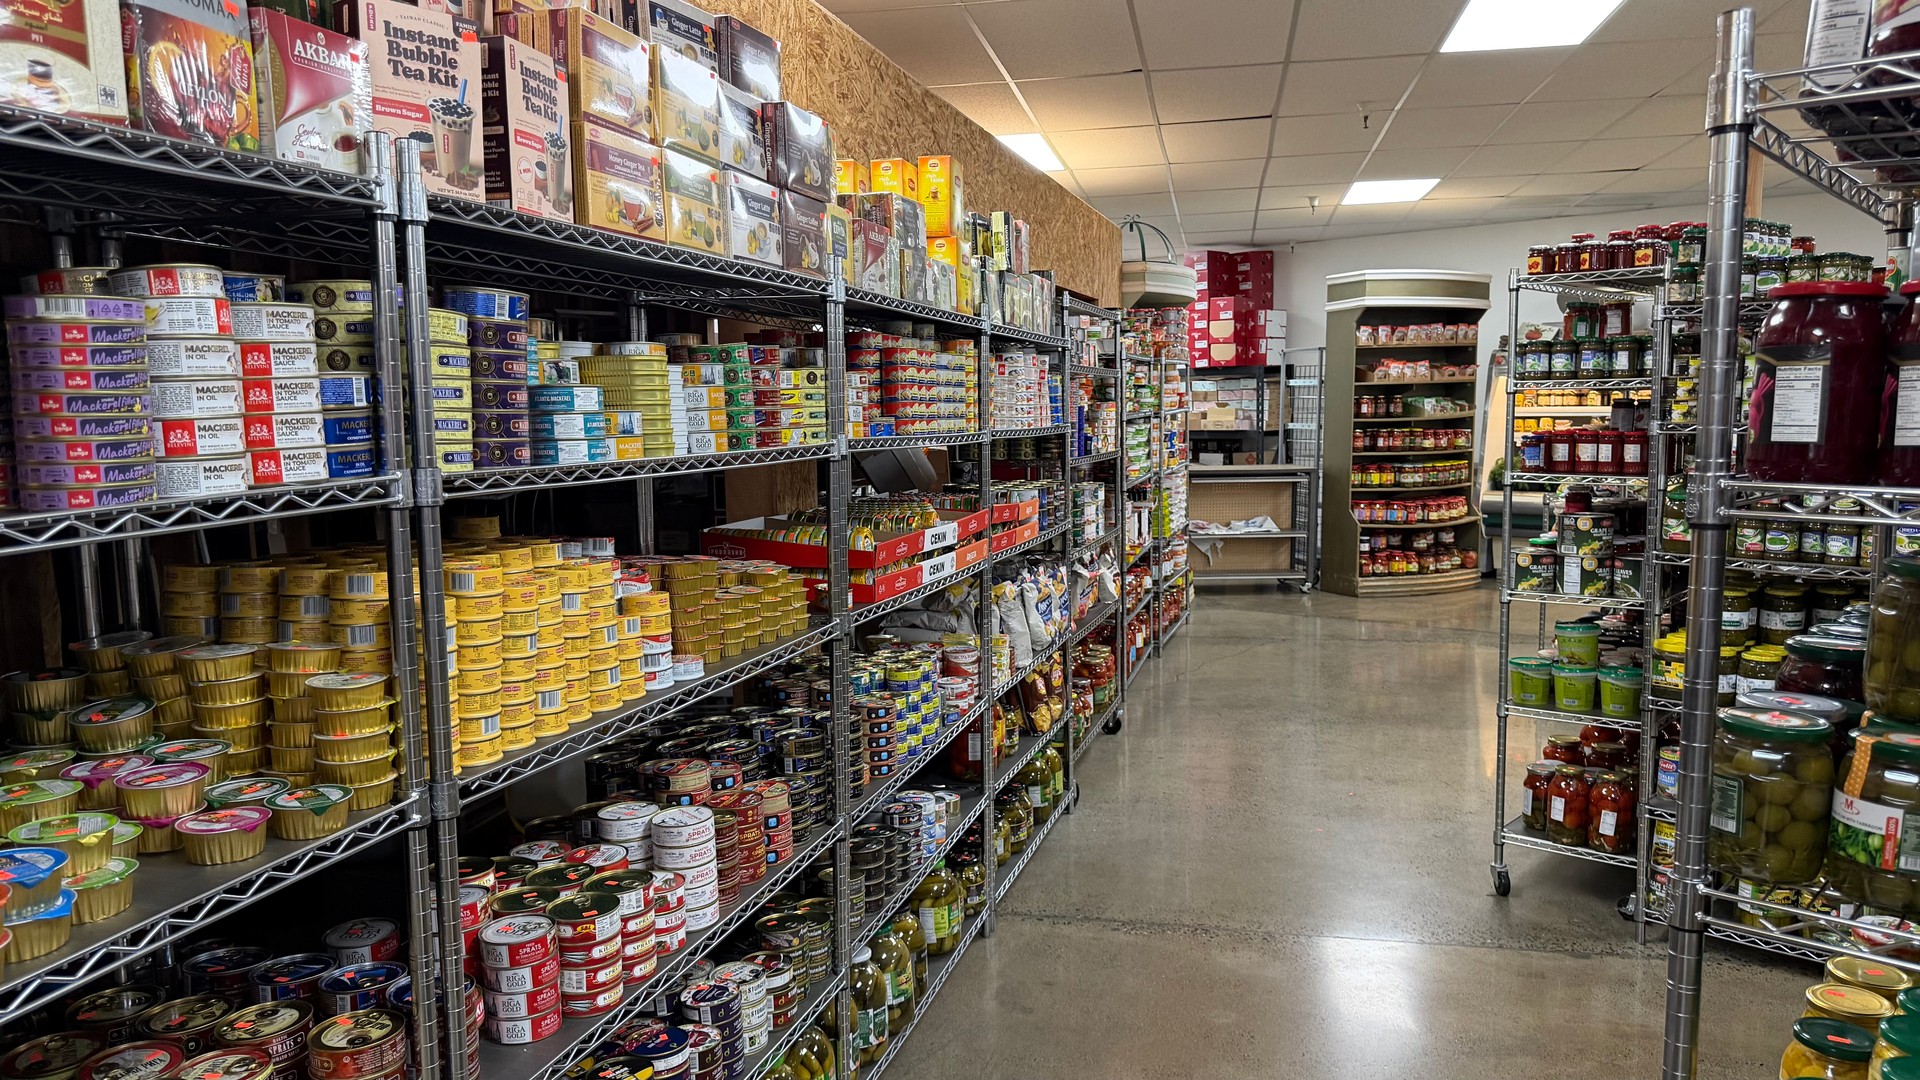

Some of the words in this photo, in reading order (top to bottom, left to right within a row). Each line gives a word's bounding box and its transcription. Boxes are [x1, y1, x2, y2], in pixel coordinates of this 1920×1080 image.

[400, 15, 421, 23] TAIWAN
[455, 21, 477, 32] FAMILY
[671, 17, 688, 32] Ginger
[688, 23, 702, 36] Latte
[383, 19, 460, 53] Instant
[386, 39, 459, 71] Bubble
[387, 58, 426, 82] Tea
[428, 66, 459, 89] Kit
[519, 60, 558, 91] Instant
[178, 80, 228, 106] CEYLON
[521, 78, 558, 107] Bubble
[375, 104, 401, 116] Brown
[401, 108, 424, 120] Sugar
[522, 94, 543, 117] Tea
[543, 103, 558, 124] Kit
[764, 122, 772, 149] Ginger
[608, 154, 623, 166] Honey
[623, 158, 638, 169] Ginger
[637, 161, 646, 172] Tea
[765, 149, 773, 171] Coffee
[747, 198, 761, 213] Ginger
[760, 201, 771, 213] Latte
[797, 213, 808, 225] Ginger
[869, 229, 884, 242] AKBAR
[266, 310, 309, 319] MACKEREL
[275, 317, 301, 325] TOMATO
[184, 344, 230, 353] MACKEREL
[272, 347, 313, 355] MACKEREL
[195, 385, 237, 395] MACKEREL
[274, 382, 315, 390] MACKEREL
[275, 417, 318, 426] MACKEREL
[197, 423, 240, 433] MACKEREL
[282, 452, 323, 461] MACKEREL
[203, 463, 244, 474] MACKEREL
[292, 459, 317, 467] TOMATO
[930, 532, 947, 546] CEKIN
[929, 560, 945, 577] CEKIN
[1844, 797, 1854, 811] M
[1856, 820, 1883, 831] TARRAGON
[687, 827, 711, 839] SPRATS
[740, 829, 761, 840] SPRATS
[689, 848, 712, 860] SPRATS
[691, 868, 714, 881] SPRATS
[519, 944, 542, 955] SPRATS
[632, 938, 653, 951] SPRATS
[541, 961, 559, 974] SPRATS
[506, 974, 526, 983] RIGA
[506, 980, 527, 988] GOLD
[536, 988, 555, 1002] SPRATS
[501, 999, 521, 1008] RIGA
[541, 1013, 559, 1027] SPRATS
[506, 1026, 526, 1034] RIGA
[506, 1032, 526, 1040] GOLD
[268, 1039, 294, 1055] SPRATS
